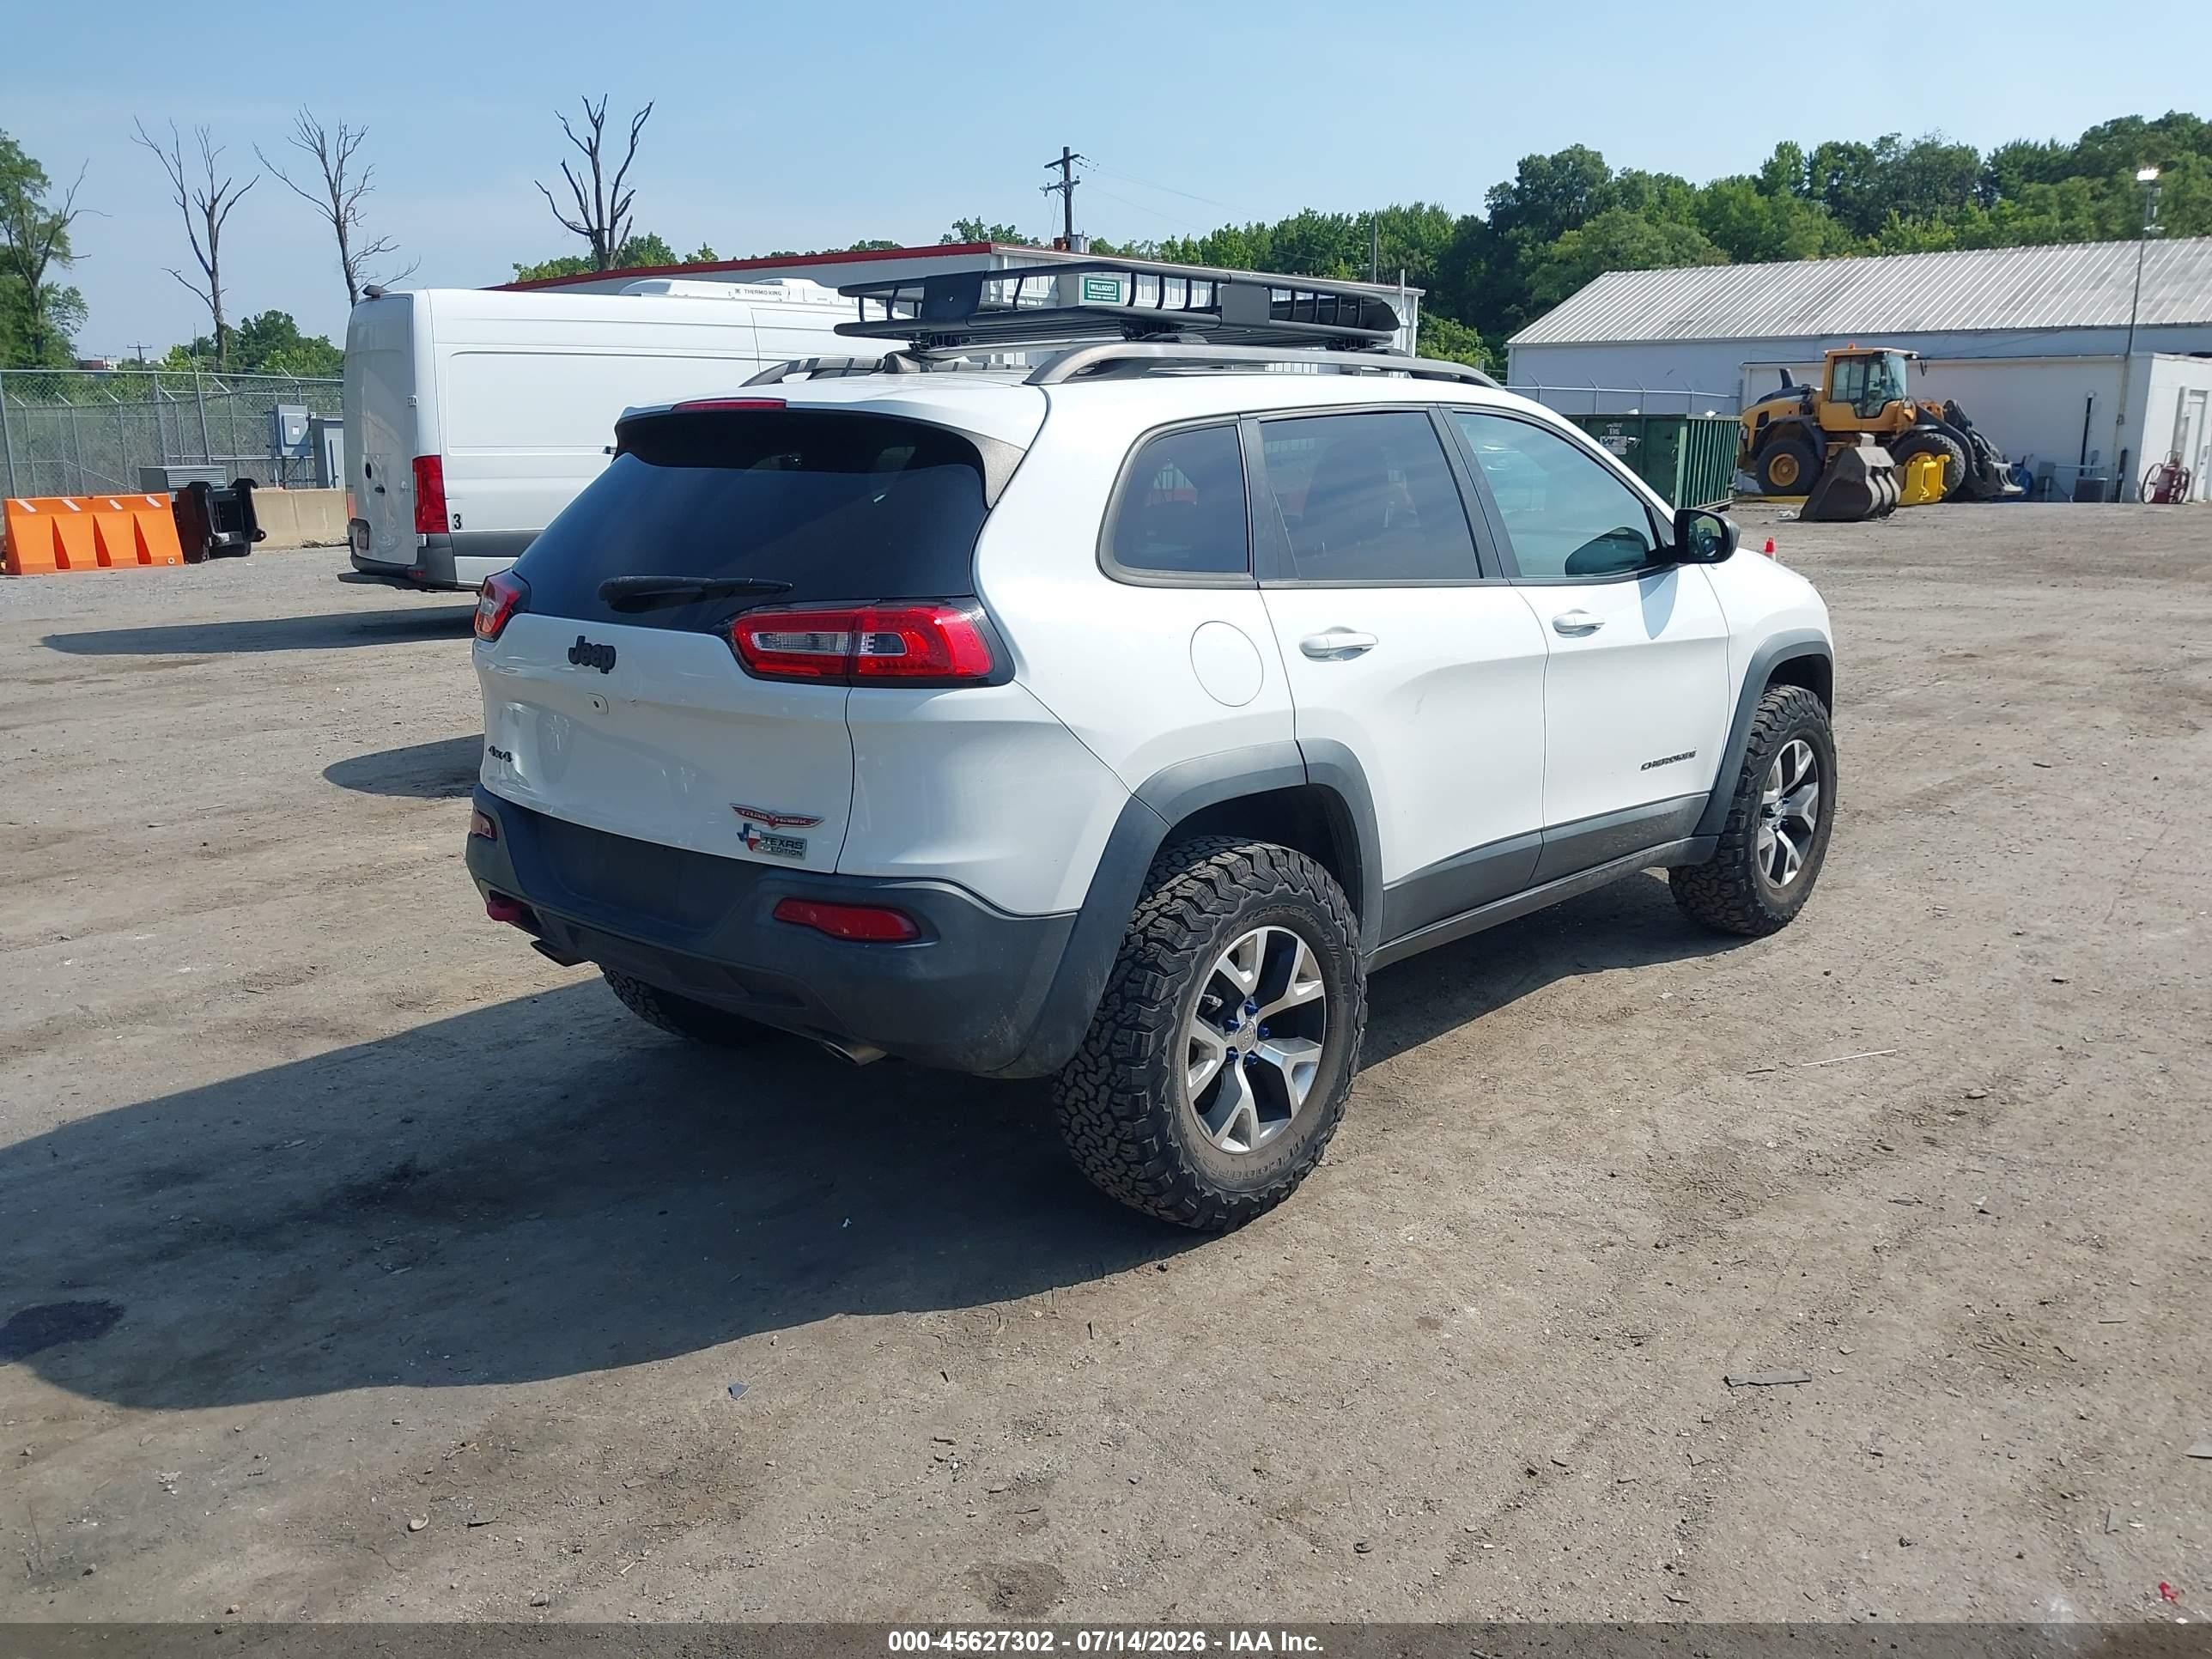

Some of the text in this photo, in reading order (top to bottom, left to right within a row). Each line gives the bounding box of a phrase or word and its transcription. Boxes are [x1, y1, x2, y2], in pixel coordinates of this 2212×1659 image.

[1090, 283, 1115, 293] WILLSCOT
[453, 514, 462, 530] 3
[568, 635, 617, 675] Jeep
[1640, 750, 1697, 771] CHEROKEE
[763, 836, 805, 850] TEXAS
[770, 847, 804, 858] EDITION
